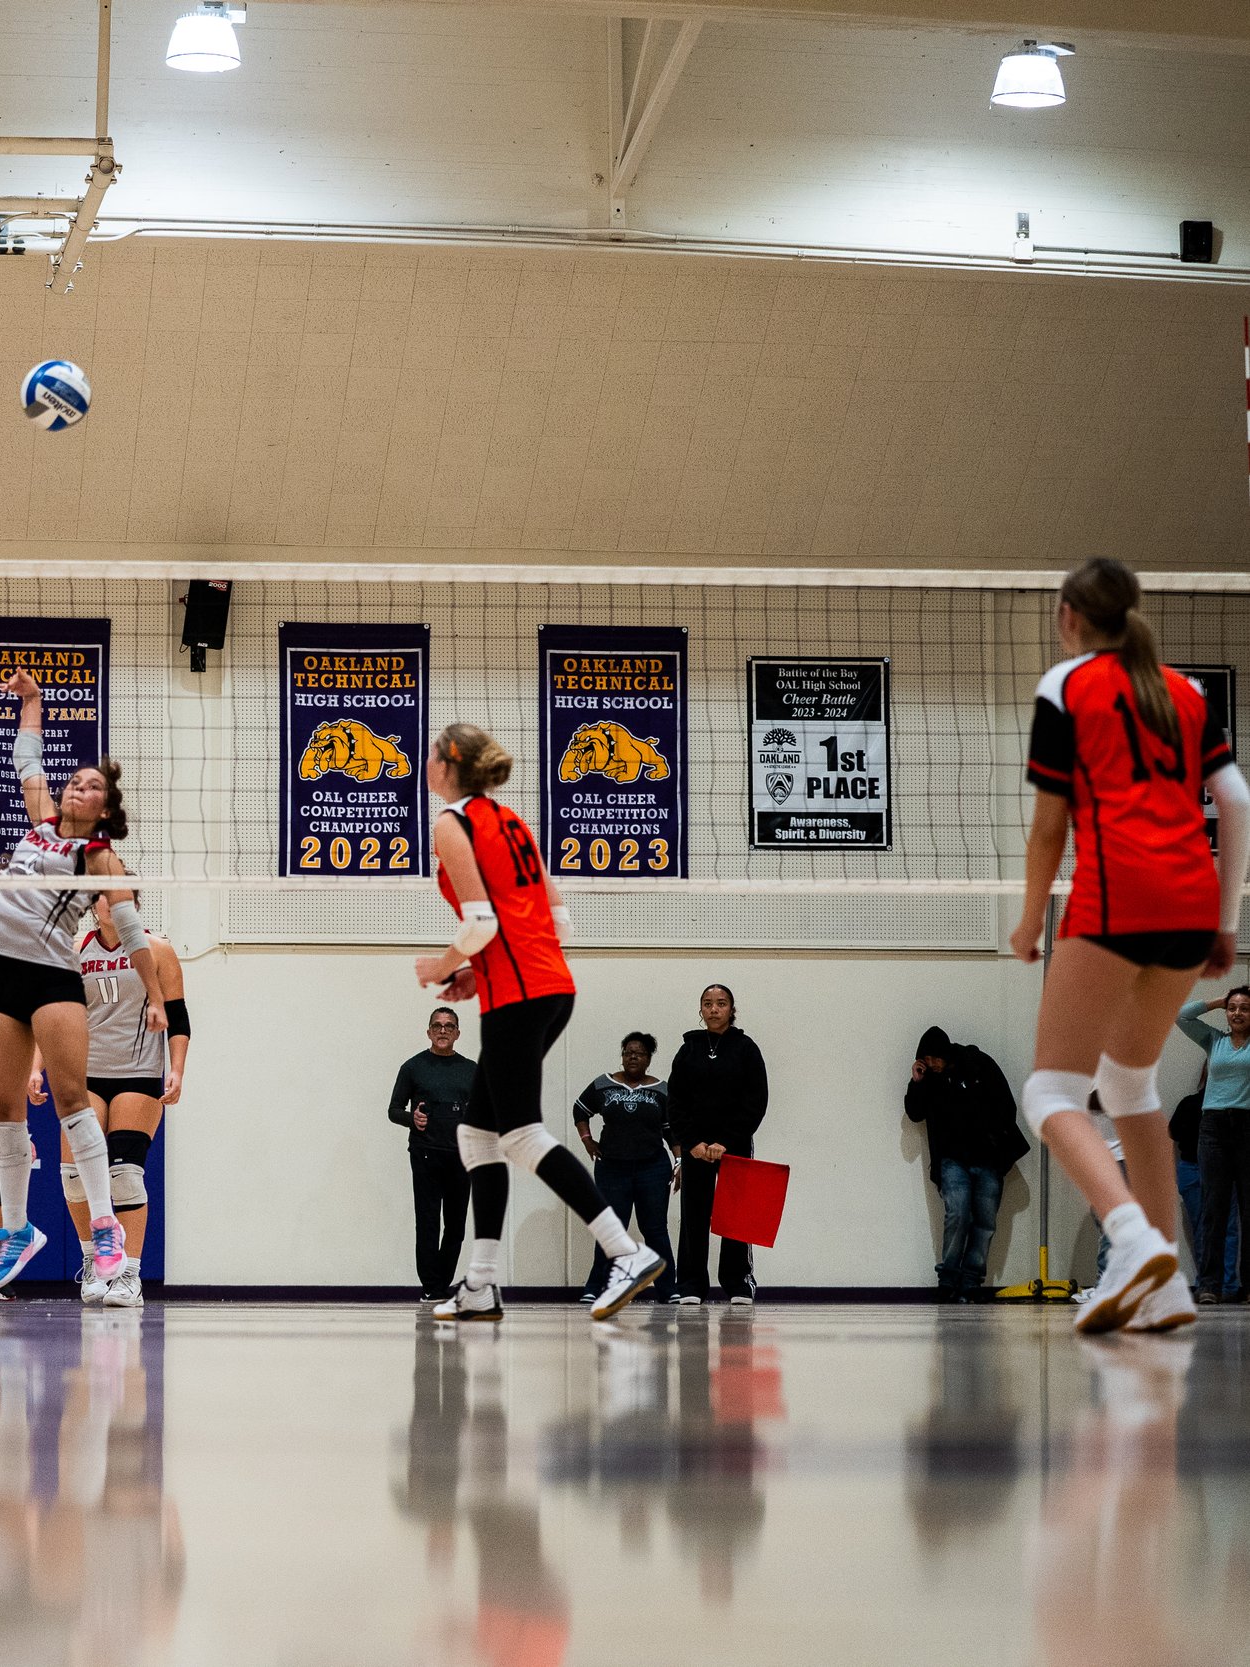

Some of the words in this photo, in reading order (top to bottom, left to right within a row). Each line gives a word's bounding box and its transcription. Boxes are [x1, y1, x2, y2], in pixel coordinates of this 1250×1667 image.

[303, 656, 405, 671] OAKLAND
[563, 658, 663, 673] OAKLAND
[778, 668, 808, 678] Battle
[810, 668, 820, 678] of
[822, 669, 837, 678] the
[840, 669, 859, 680] Bay
[294, 673, 416, 688] TECHNICAL
[554, 675, 674, 691] TECHNICAL
[776, 680, 800, 690] OAL
[802, 680, 826, 692] High
[828, 681, 861, 690] School
[40, 688, 95, 701] HOOL
[295, 693, 339, 707] HIGH
[343, 694, 415, 708] SCHOOL
[782, 693, 819, 705] Cheer
[821, 694, 857, 705] Battle
[555, 696, 599, 709] HIGH
[602, 696, 673, 710] SCHOOL
[48, 707, 97, 721] FAME
[791, 707, 815, 717] 2023
[823, 707, 847, 718] 2024
[759, 753, 800, 764] OAKLAND
[819, 735, 866, 772] 1st
[41, 758, 79, 767] AMPTON
[45, 772, 74, 781] HNSON
[806, 777, 880, 799] PLACE
[312, 791, 343, 803] OAL
[347, 791, 398, 803] CHEER
[572, 793, 602, 805] OAL
[607, 793, 657, 805] CHEER
[9, 799, 26, 808] LEO
[300, 806, 409, 818] COMPETITION
[560, 808, 669, 820] COMPETITION
[309, 821, 400, 834] CHAMPIONS
[790, 817, 851, 828] Awareness,
[569, 823, 660, 835] CHAMPIONS
[775, 829, 807, 840] Spirit,
[809, 829, 817, 839] &
[818, 829, 866, 840] Diversity
[4, 842, 18, 851] JOS
[300, 836, 410, 869] 2022
[560, 838, 670, 870] 2023
[81, 957, 134, 975] BREWE
[96, 976, 119, 1004] 11
[605, 1092, 658, 1107] Raiders
